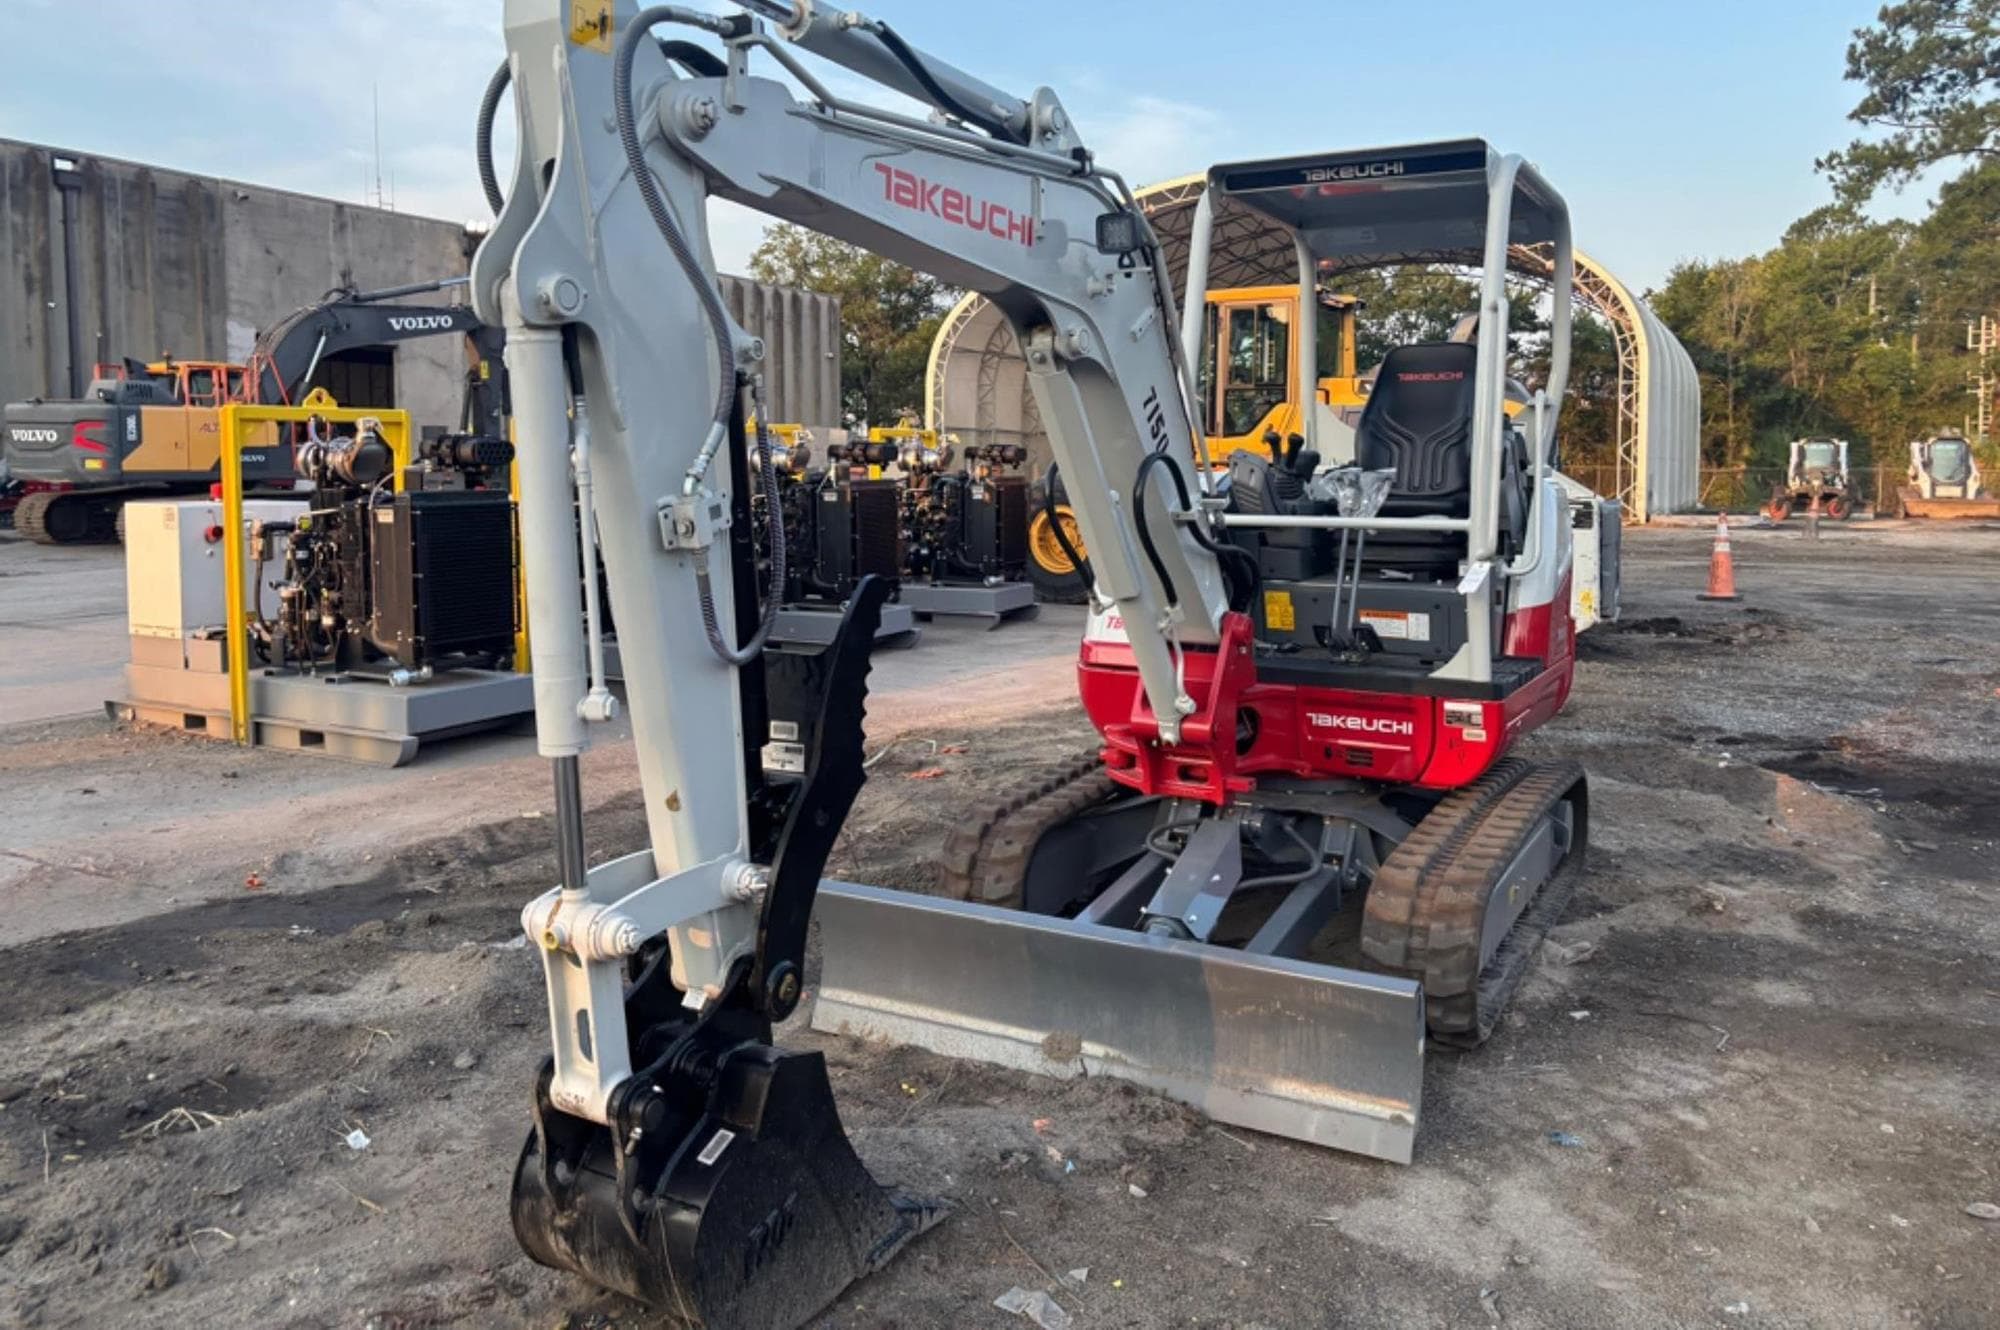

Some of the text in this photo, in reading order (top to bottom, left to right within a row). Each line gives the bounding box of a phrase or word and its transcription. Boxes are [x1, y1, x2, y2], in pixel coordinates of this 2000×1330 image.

[387, 315, 453, 331] VOLVO
[10, 429, 58, 443] VOLVO
[240, 454, 265, 462] OLVO
